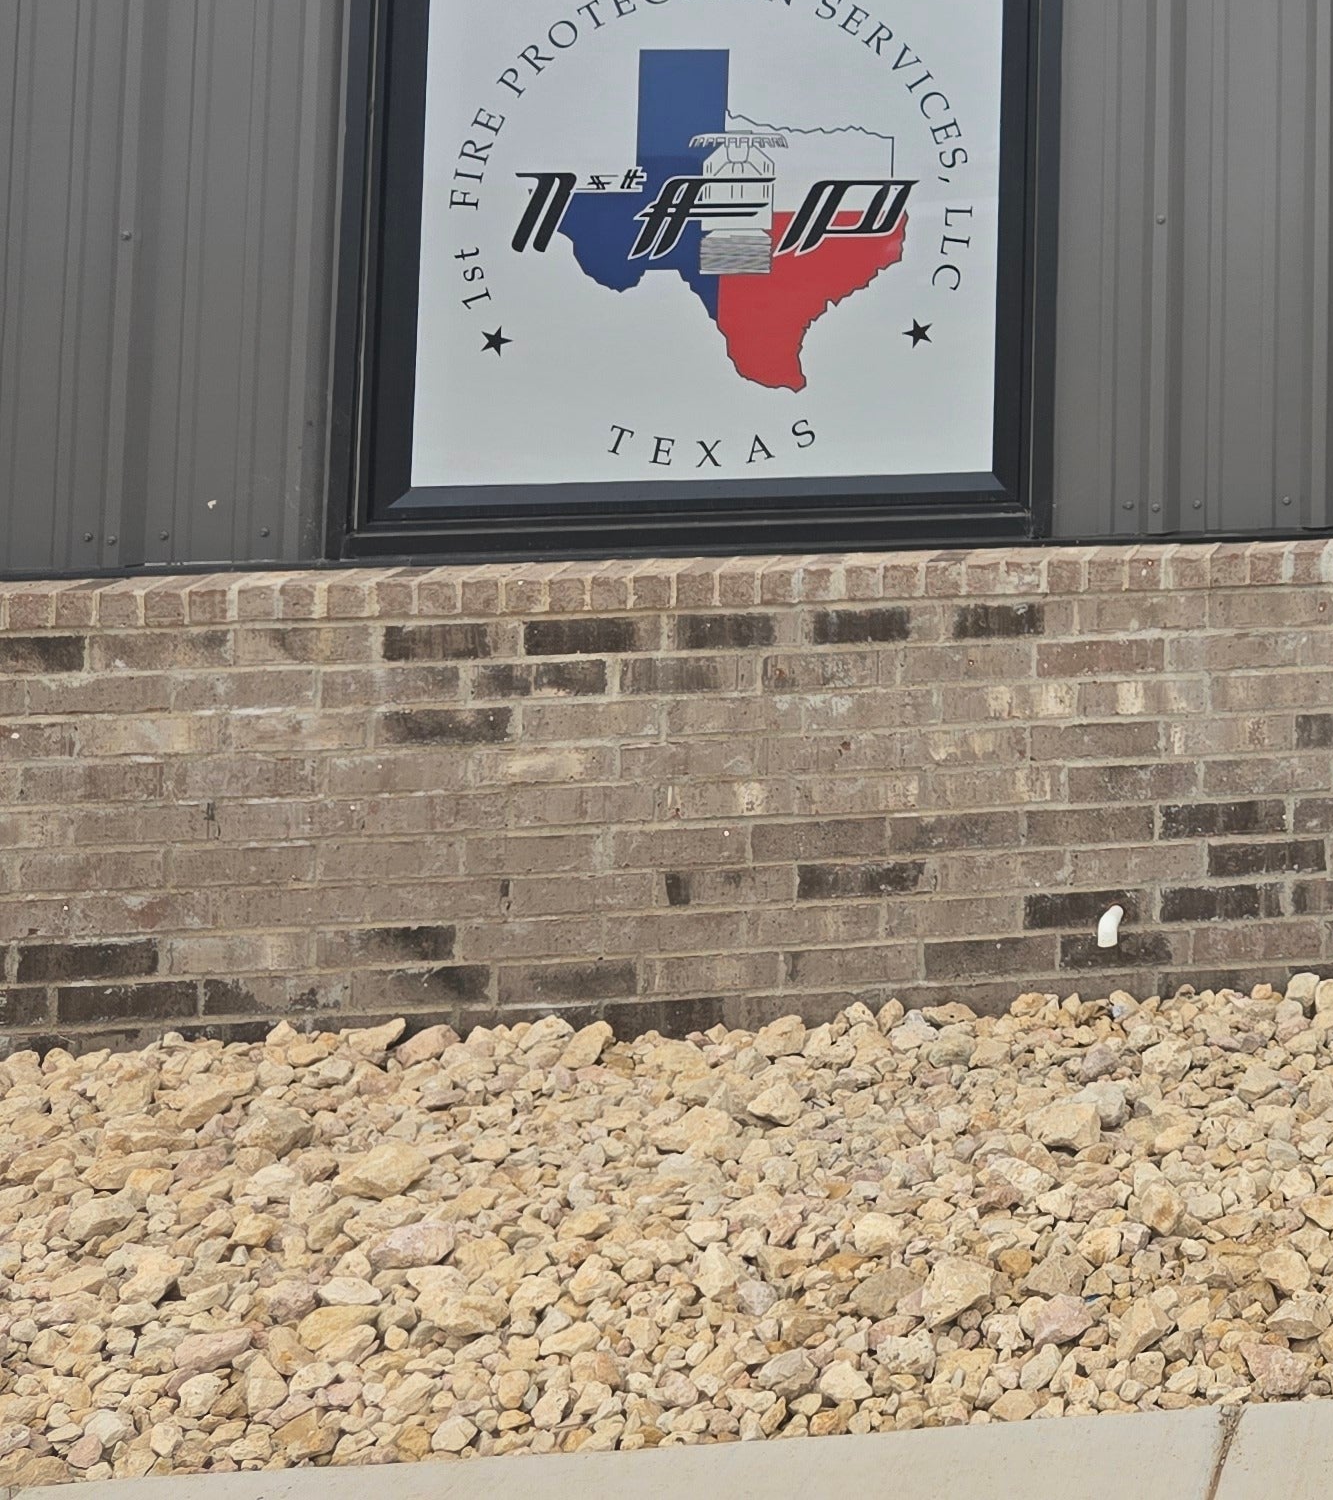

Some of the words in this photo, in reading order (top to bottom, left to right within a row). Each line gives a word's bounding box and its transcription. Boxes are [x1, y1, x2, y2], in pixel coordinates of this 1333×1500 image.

[449, 107, 506, 211] FIRE
[454, 245, 493, 310] 1st
[930, 205, 974, 292] LLC
[606, 417, 816, 469] TEXAS
